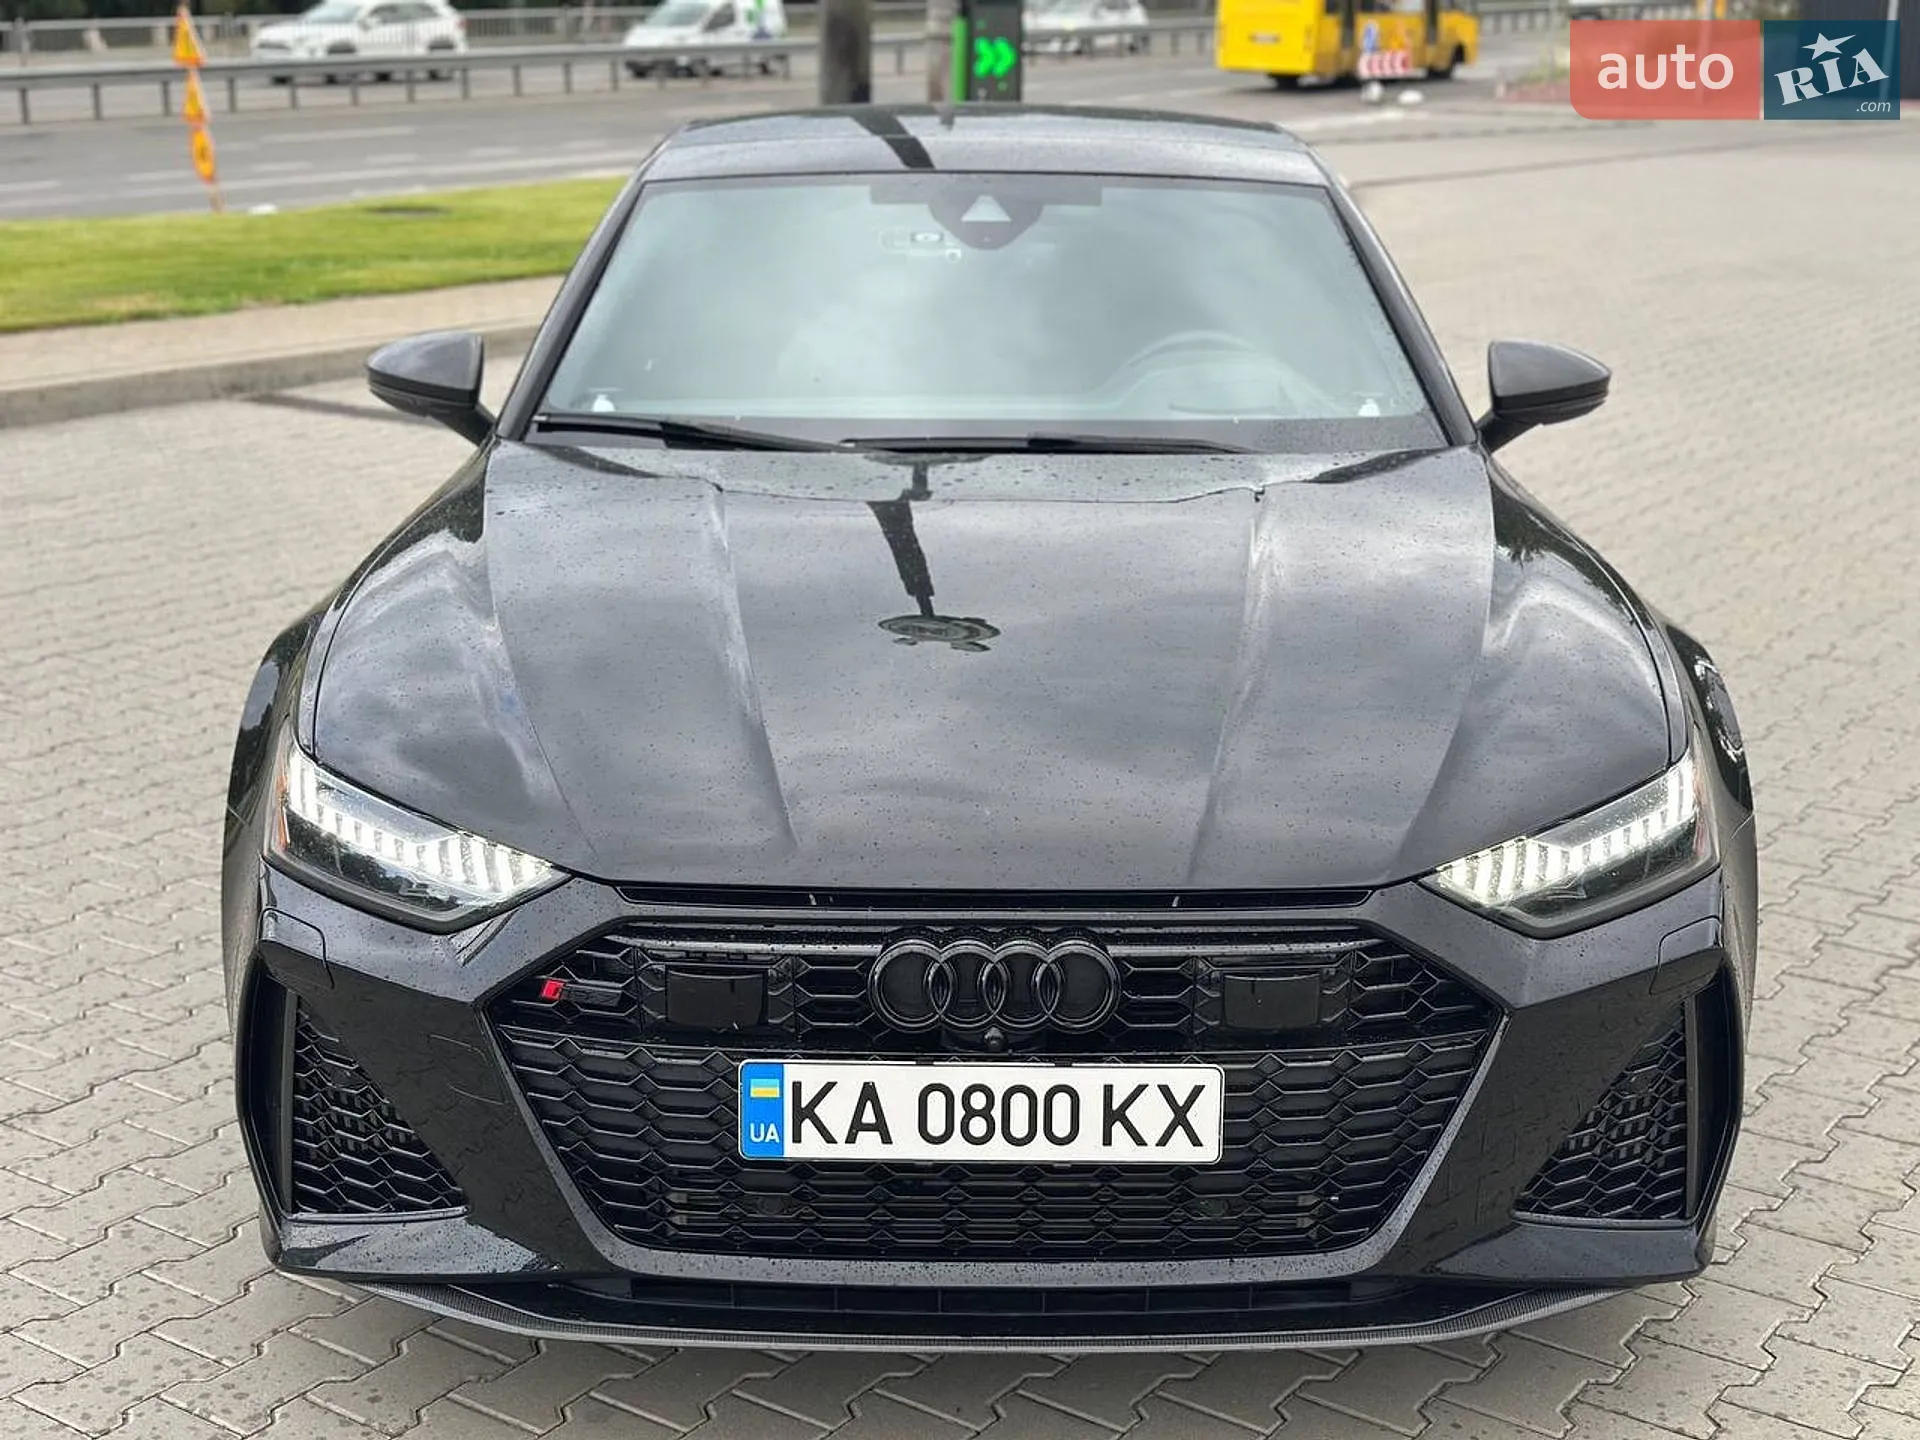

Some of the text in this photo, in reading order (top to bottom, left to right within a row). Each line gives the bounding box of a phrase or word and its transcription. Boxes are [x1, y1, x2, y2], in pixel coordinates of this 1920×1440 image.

[750, 1122, 780, 1144] UA
[791, 1080, 1206, 1148] KA 0800 KX
